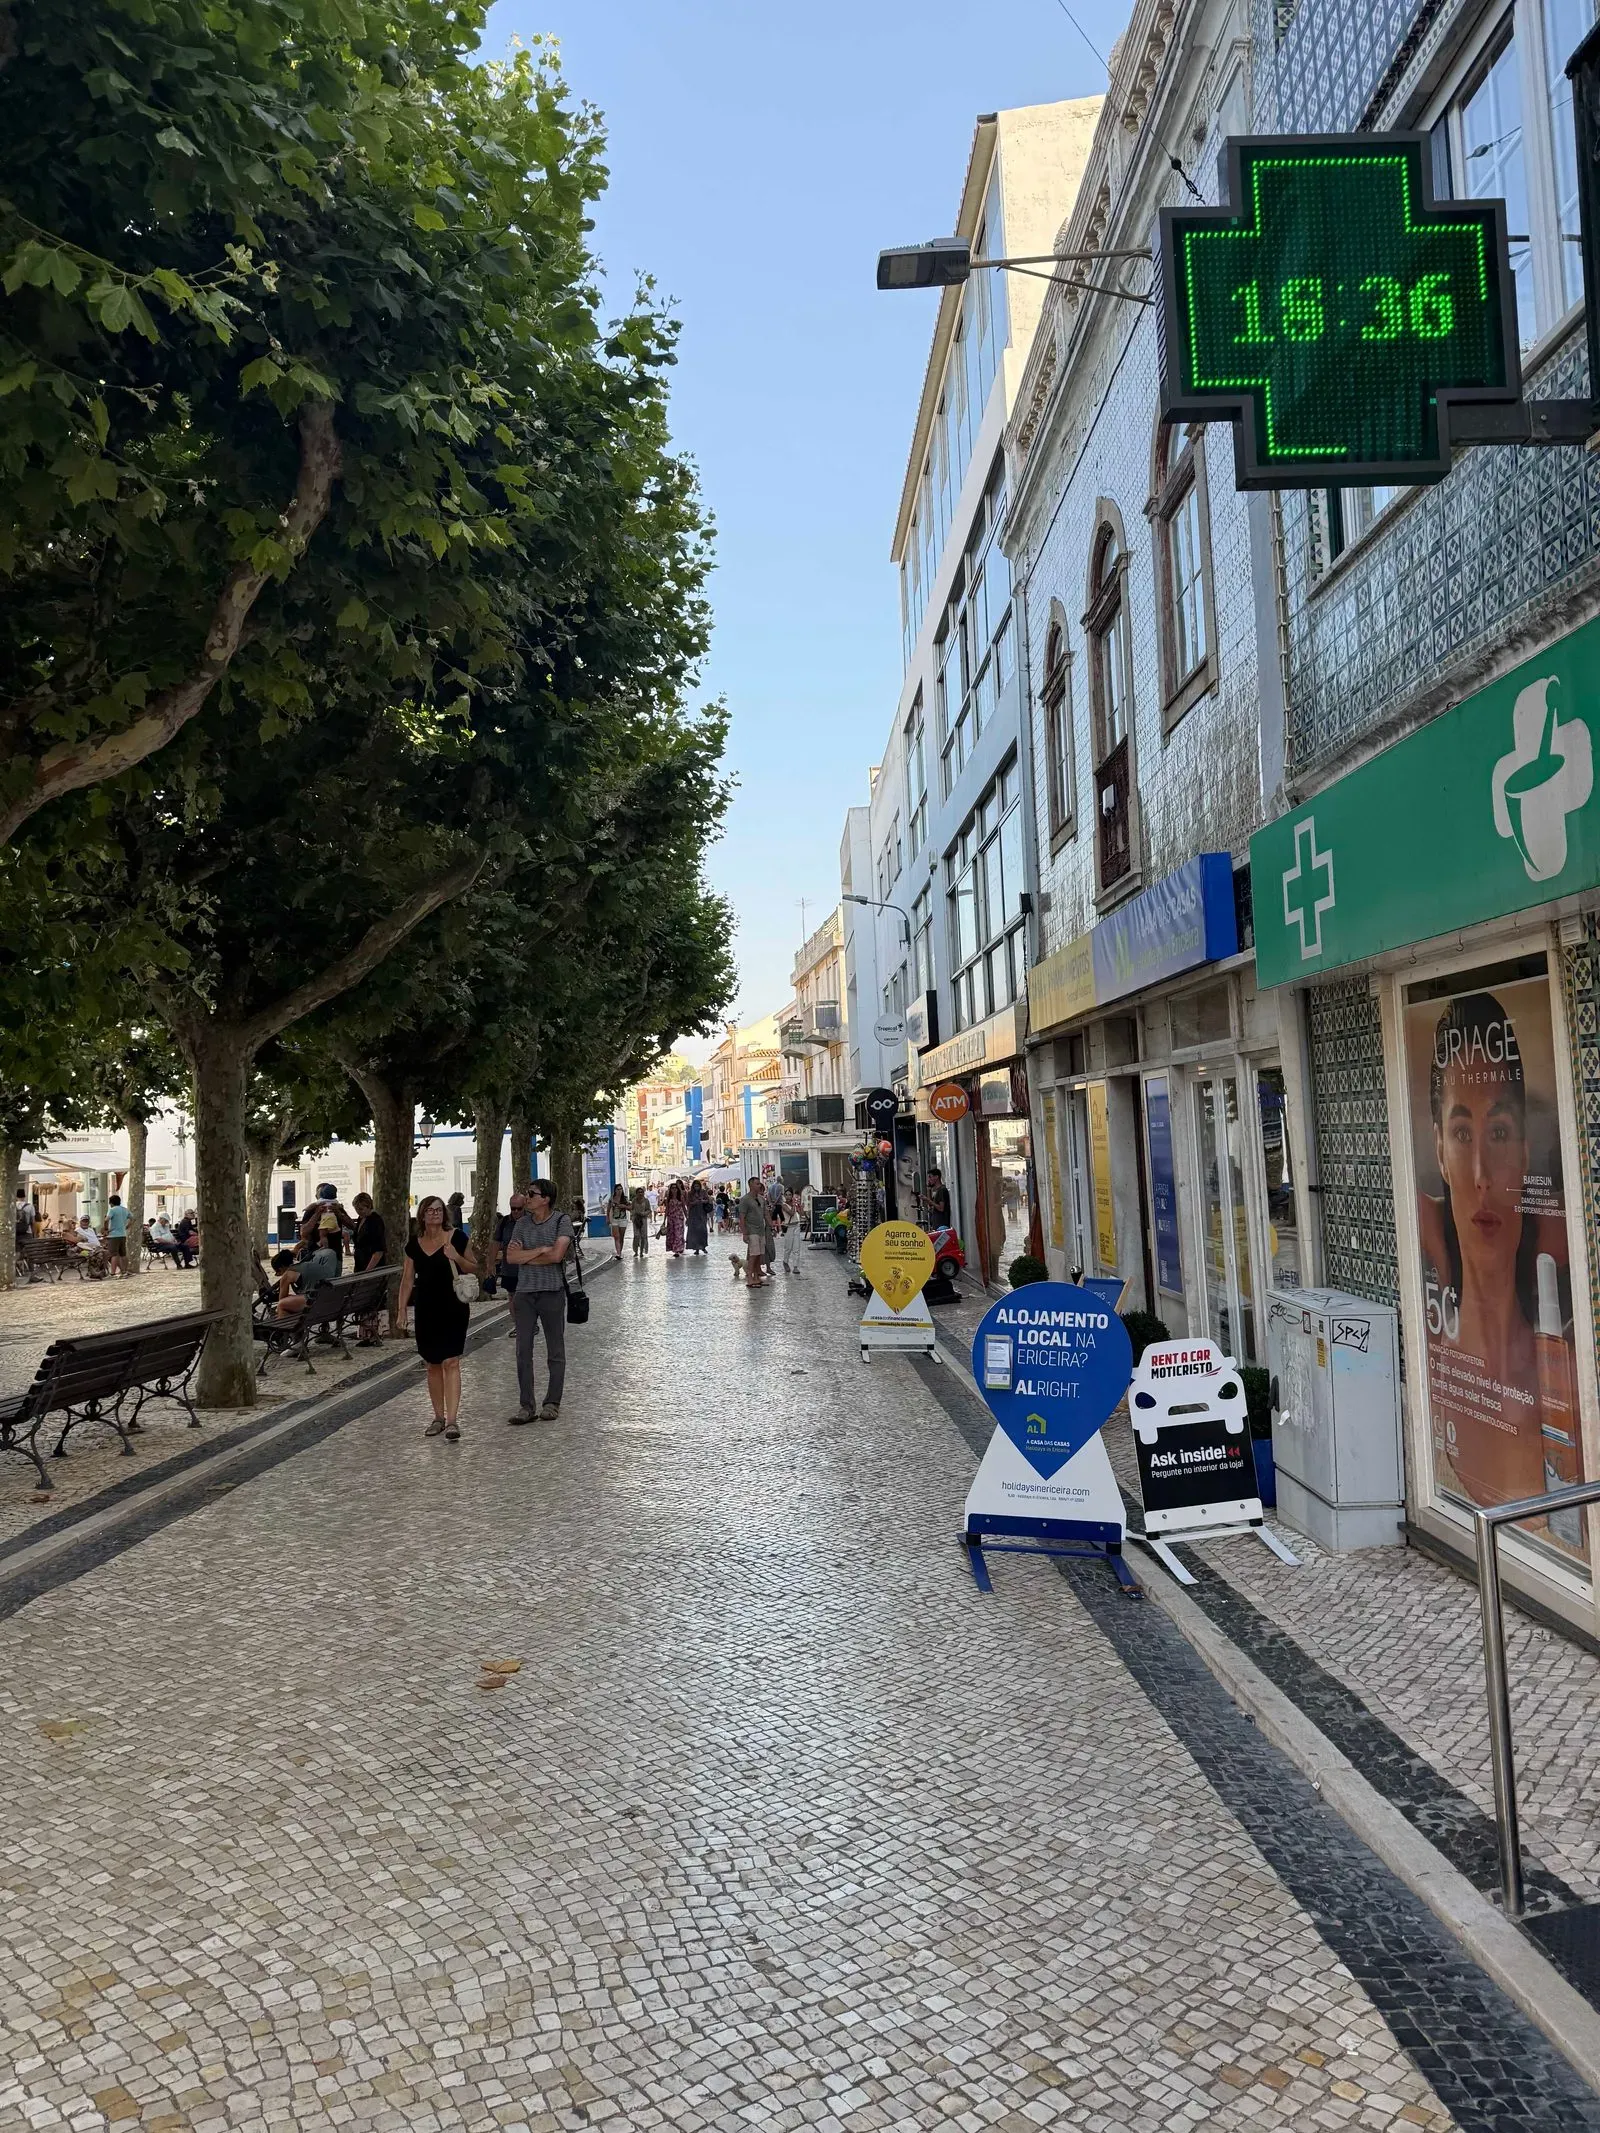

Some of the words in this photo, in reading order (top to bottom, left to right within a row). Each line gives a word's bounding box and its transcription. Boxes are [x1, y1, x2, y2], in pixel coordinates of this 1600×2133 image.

[1231, 273, 1454, 343] 18:36
[1172, 886, 1196, 920] CASAS
[1171, 926, 1199, 957] Ericeira
[1434, 1018, 1520, 1070] URIAGE
[1436, 1071, 1456, 1086] EAU
[1462, 1068, 1522, 1085] THERMALE
[934, 1094, 966, 1110] ATM
[885, 1230, 910, 1239] Agarre
[900, 1240, 926, 1248] sonho!
[996, 1308, 1108, 1330] ALOJAMENTO
[1018, 1328, 1072, 1348] LOCAL
[1076, 1331, 1096, 1348] NA
[1018, 1349, 1088, 1368] ERICEIRA?
[1151, 1352, 1179, 1366] RENT
[1181, 1351, 1189, 1364] A
[1190, 1349, 1211, 1362] CAR
[1151, 1362, 1213, 1380] MOTICRISTO
[1015, 1379, 1080, 1398] ALRIGHT.
[1430, 1357, 1436, 1370] O
[1436, 1362, 1451, 1374] mais
[1452, 1367, 1476, 1384] elevado
[1476, 1374, 1492, 1390] nível
[1492, 1378, 1502, 1394] de
[1503, 1386, 1535, 1406] proteção
[1432, 1378, 1448, 1390] numa
[1448, 1380, 1464, 1398] água
[1464, 1388, 1480, 1402] solar
[1481, 1393, 1502, 1412] fresca
[1464, 1406, 1474, 1417] POR
[1027, 1424, 1038, 1434] AL
[1150, 1450, 1178, 1468] Ask
[1179, 1445, 1228, 1464] inside!
[1151, 1466, 1183, 1479] Pergunte
[1184, 1467, 1193, 1475] no
[1194, 1464, 1218, 1474] interior
[1219, 1462, 1228, 1471] da
[1229, 1460, 1244, 1472] loja!
[1002, 1480, 1090, 1496] holidaysinericeira.com
